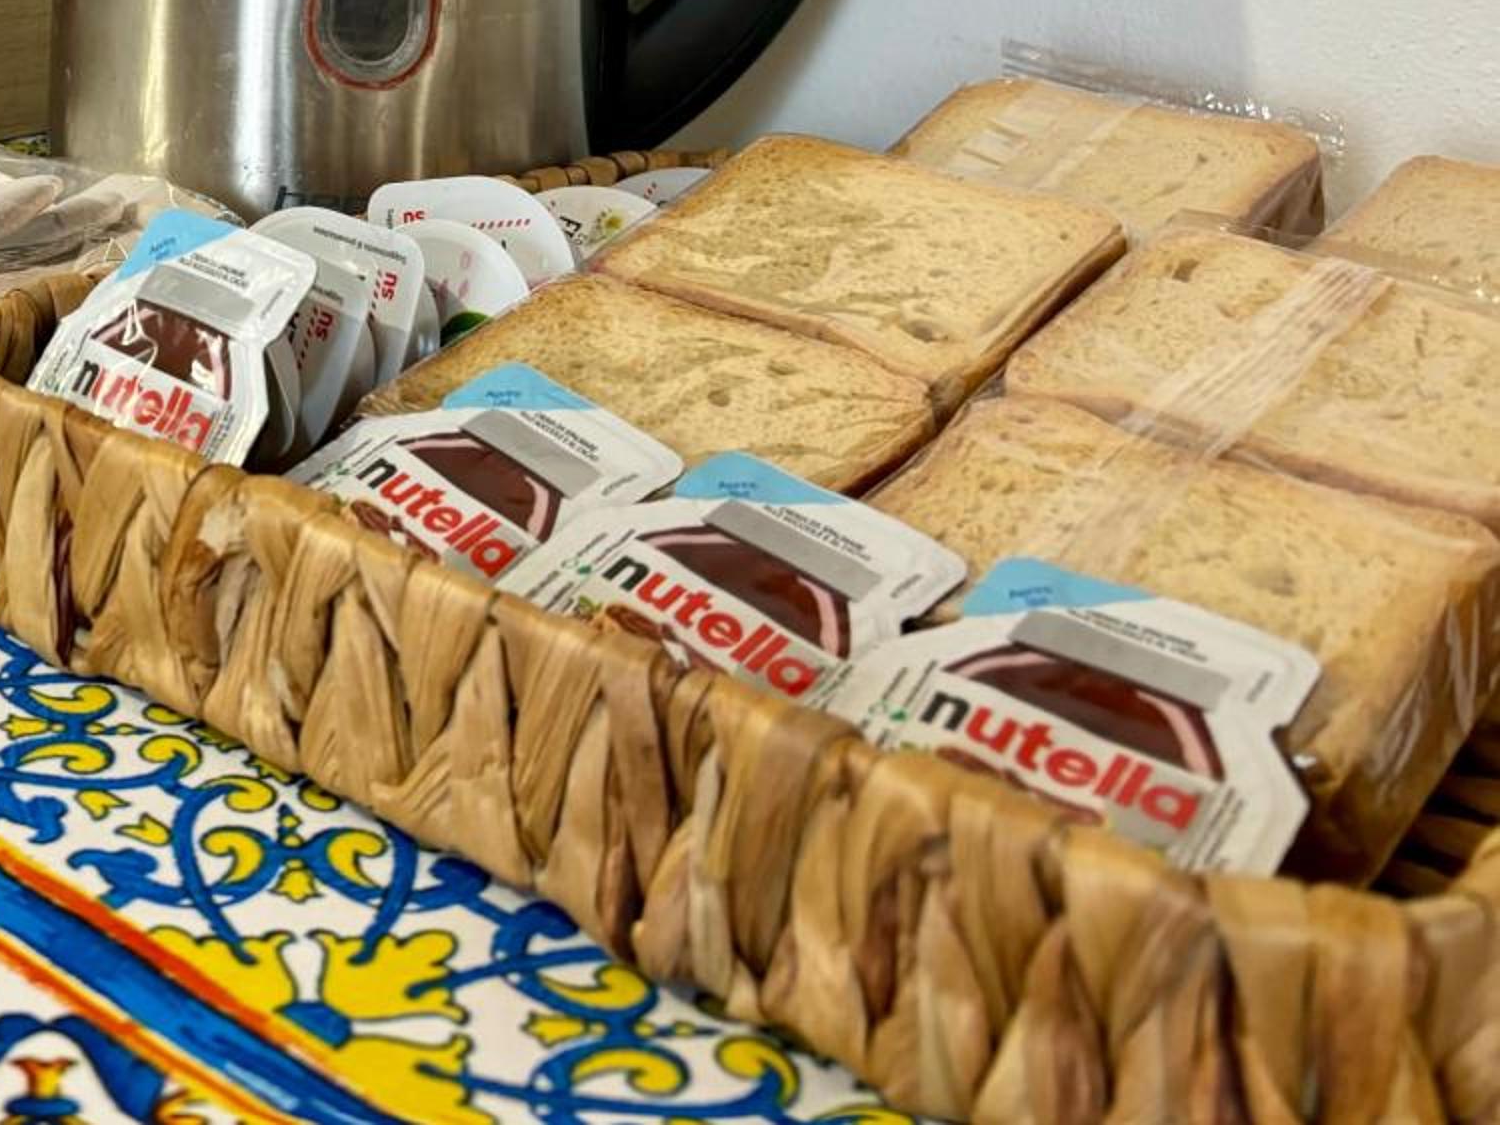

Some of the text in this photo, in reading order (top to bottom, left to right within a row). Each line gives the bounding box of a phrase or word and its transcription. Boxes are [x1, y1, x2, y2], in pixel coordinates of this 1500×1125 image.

[71, 356, 213, 454] nutella
[357, 457, 517, 579] nutella
[602, 555, 820, 697] nutella
[919, 690, 1199, 834] nutella
